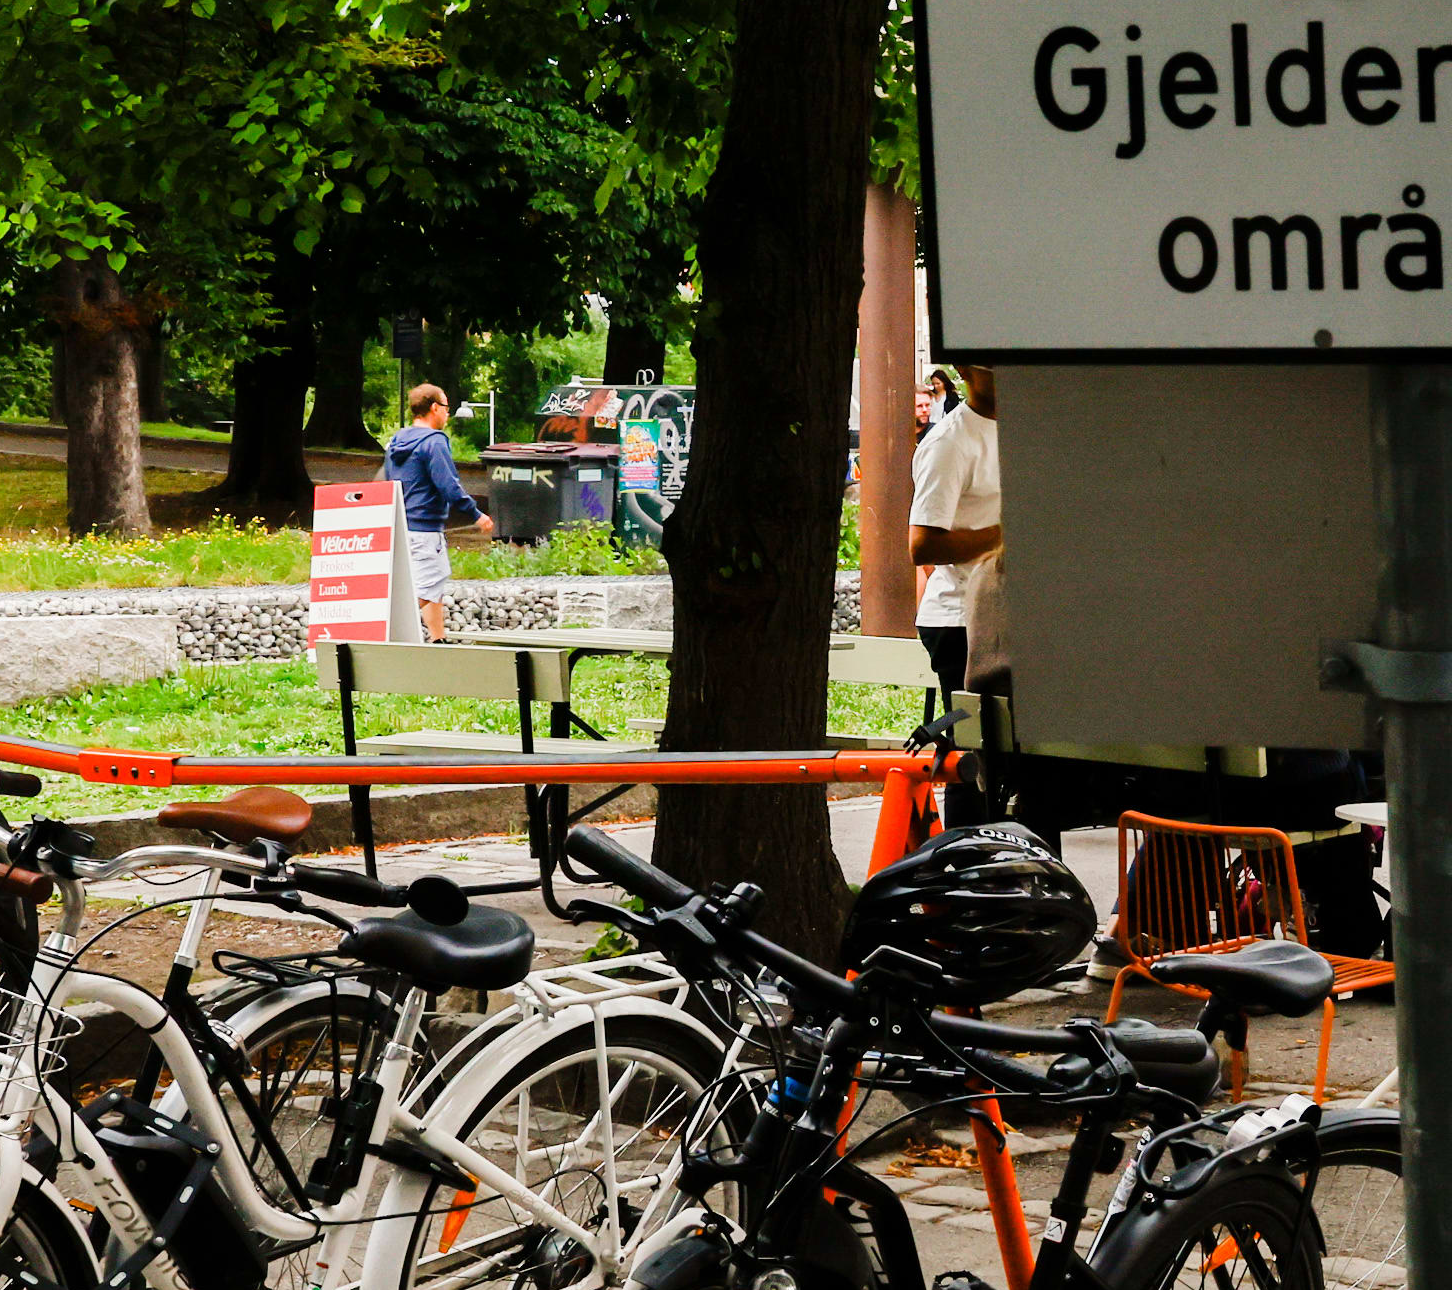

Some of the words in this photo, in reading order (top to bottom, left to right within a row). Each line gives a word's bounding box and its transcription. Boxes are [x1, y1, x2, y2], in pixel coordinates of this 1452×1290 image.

[320, 560, 355, 573] Frokost
[318, 582, 348, 596] Lunch
[317, 606, 353, 620] Middag
